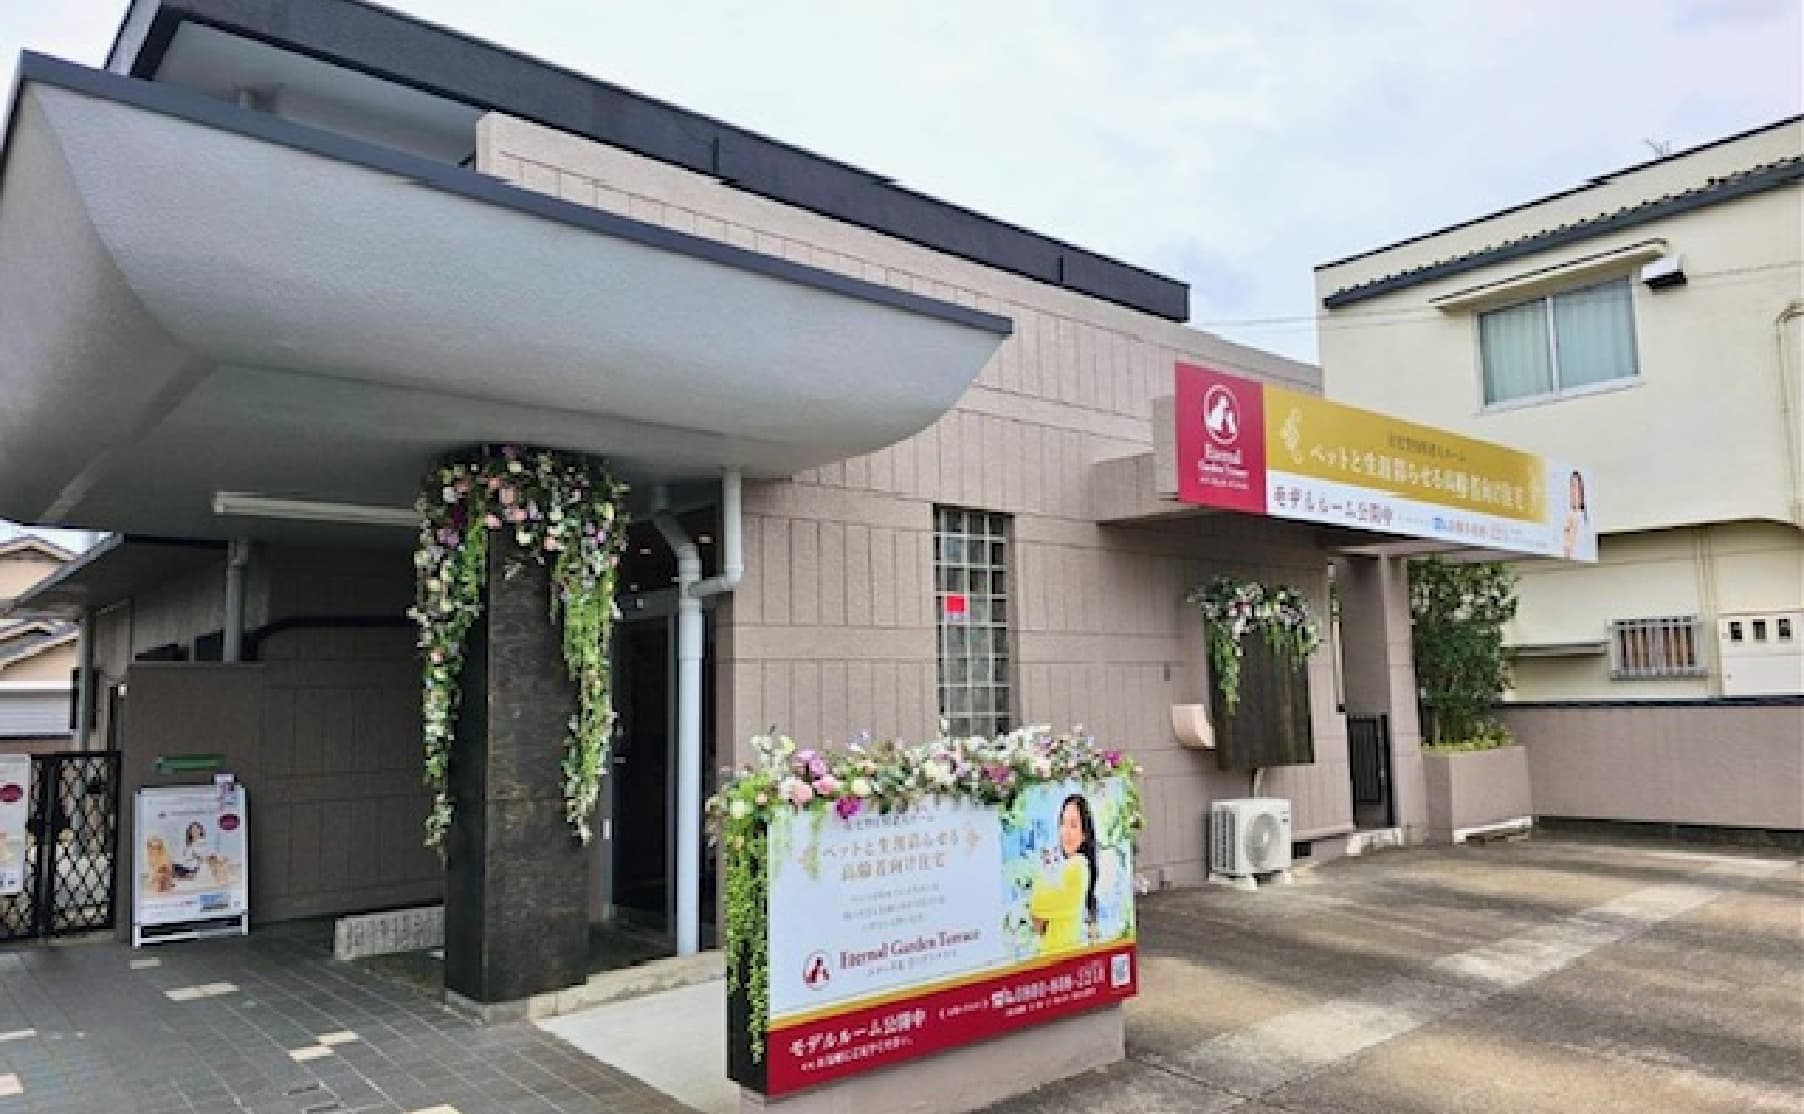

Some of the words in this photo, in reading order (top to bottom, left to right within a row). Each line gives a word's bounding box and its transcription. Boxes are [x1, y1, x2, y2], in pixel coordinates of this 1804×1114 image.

[840, 942, 889, 969] Eternal
[890, 935, 937, 955] Garden
[938, 928, 982, 947] Terrace
[788, 1007, 927, 1057] モデルルーム公開中
